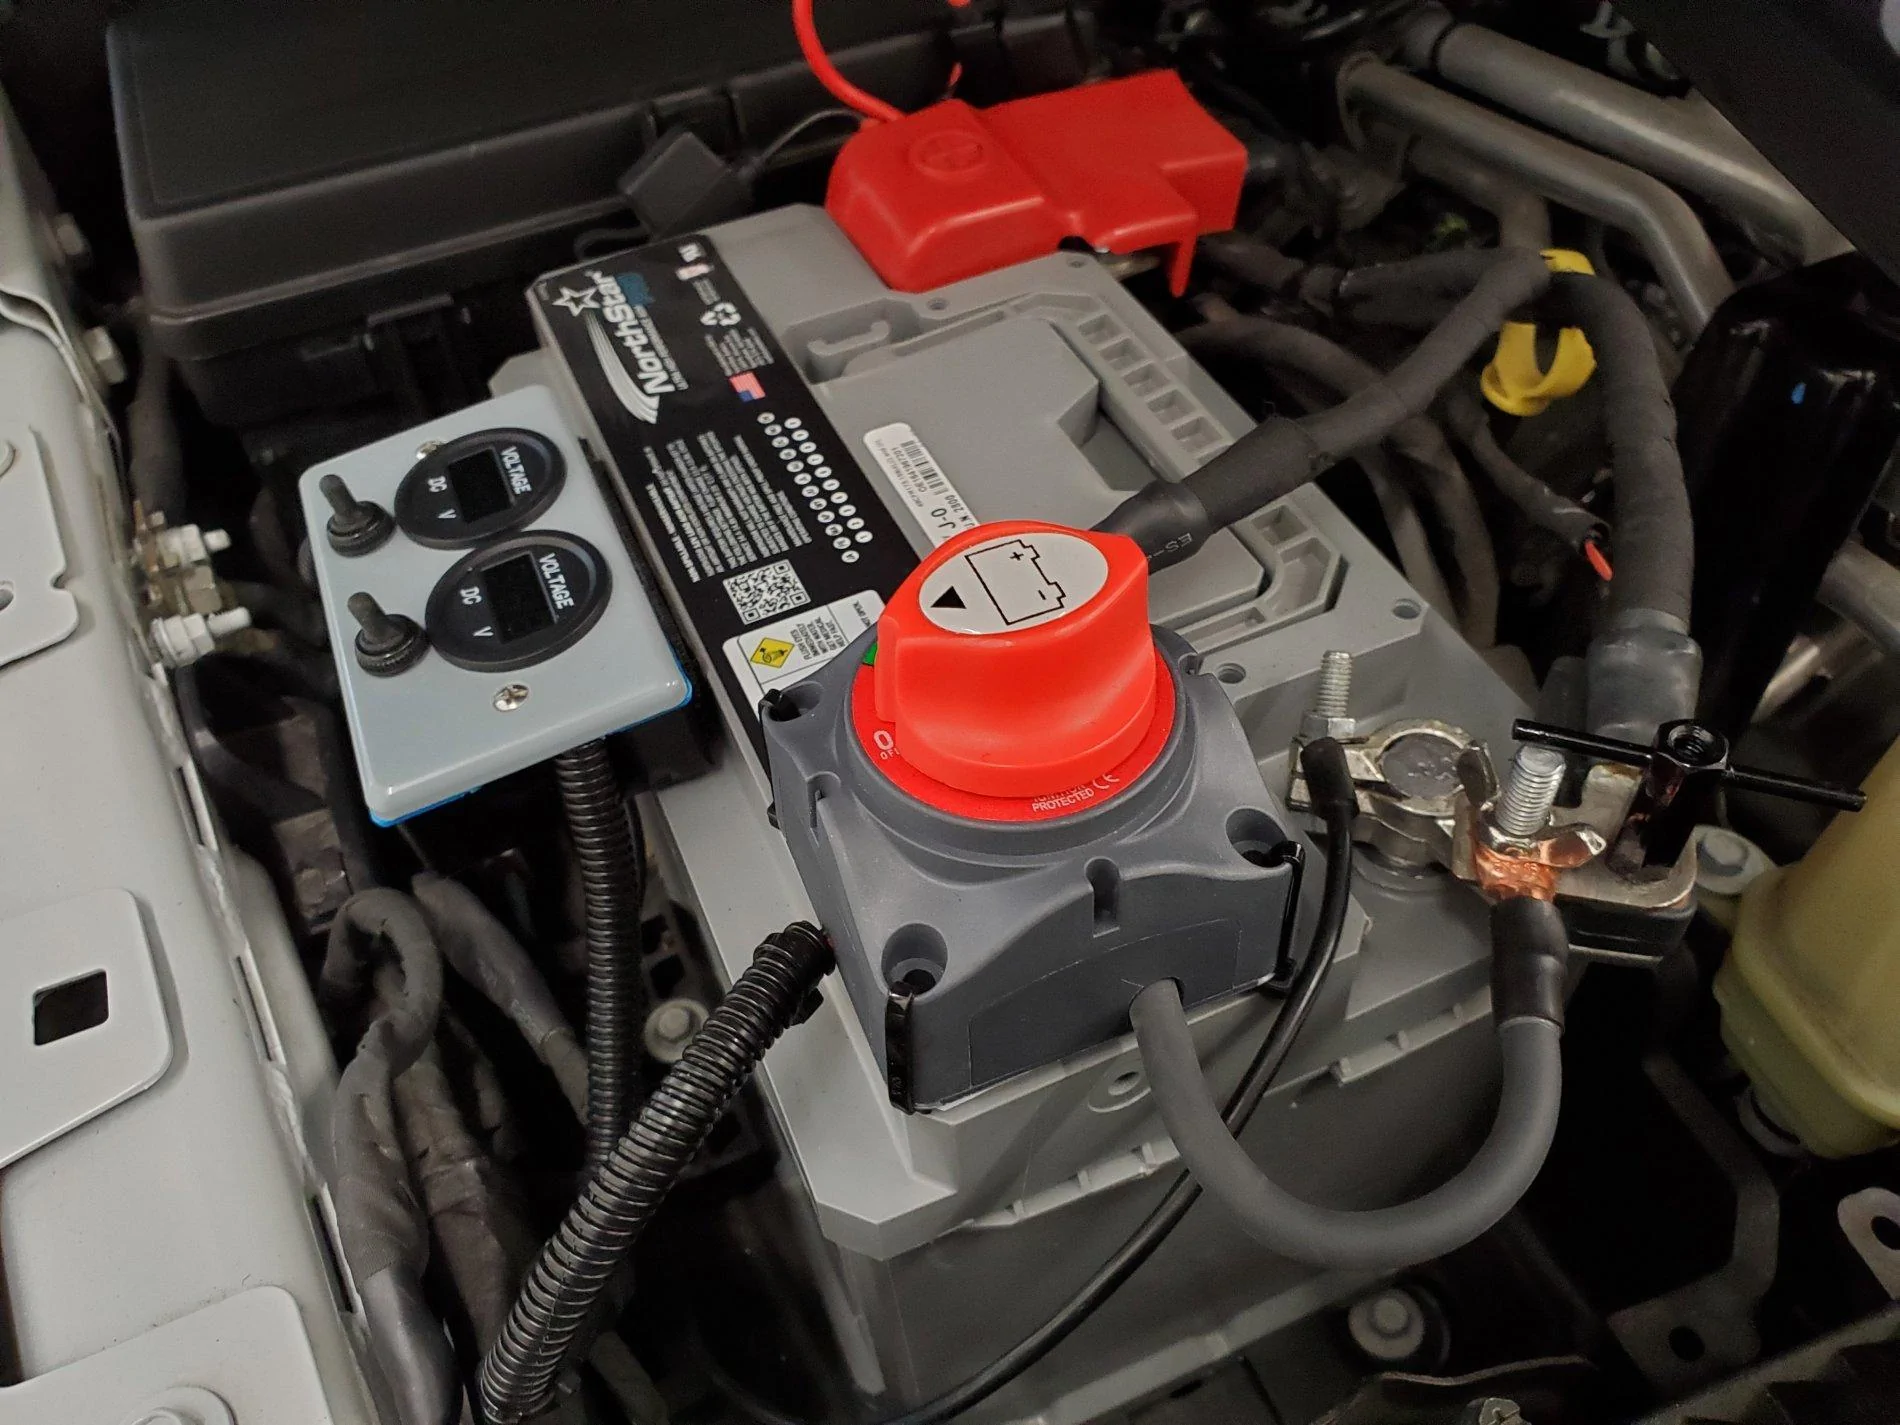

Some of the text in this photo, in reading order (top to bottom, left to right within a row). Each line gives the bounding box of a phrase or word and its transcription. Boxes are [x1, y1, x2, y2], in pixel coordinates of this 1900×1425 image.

[593, 271, 676, 394] NorthStar
[500, 445, 532, 495] VOLTAGE
[427, 475, 446, 493] DC
[437, 509, 457, 520] V
[539, 552, 575, 610] VOLTAGE
[460, 586, 483, 605] DC
[473, 626, 494, 638] V
[1032, 787, 1094, 812] PROTECTED
